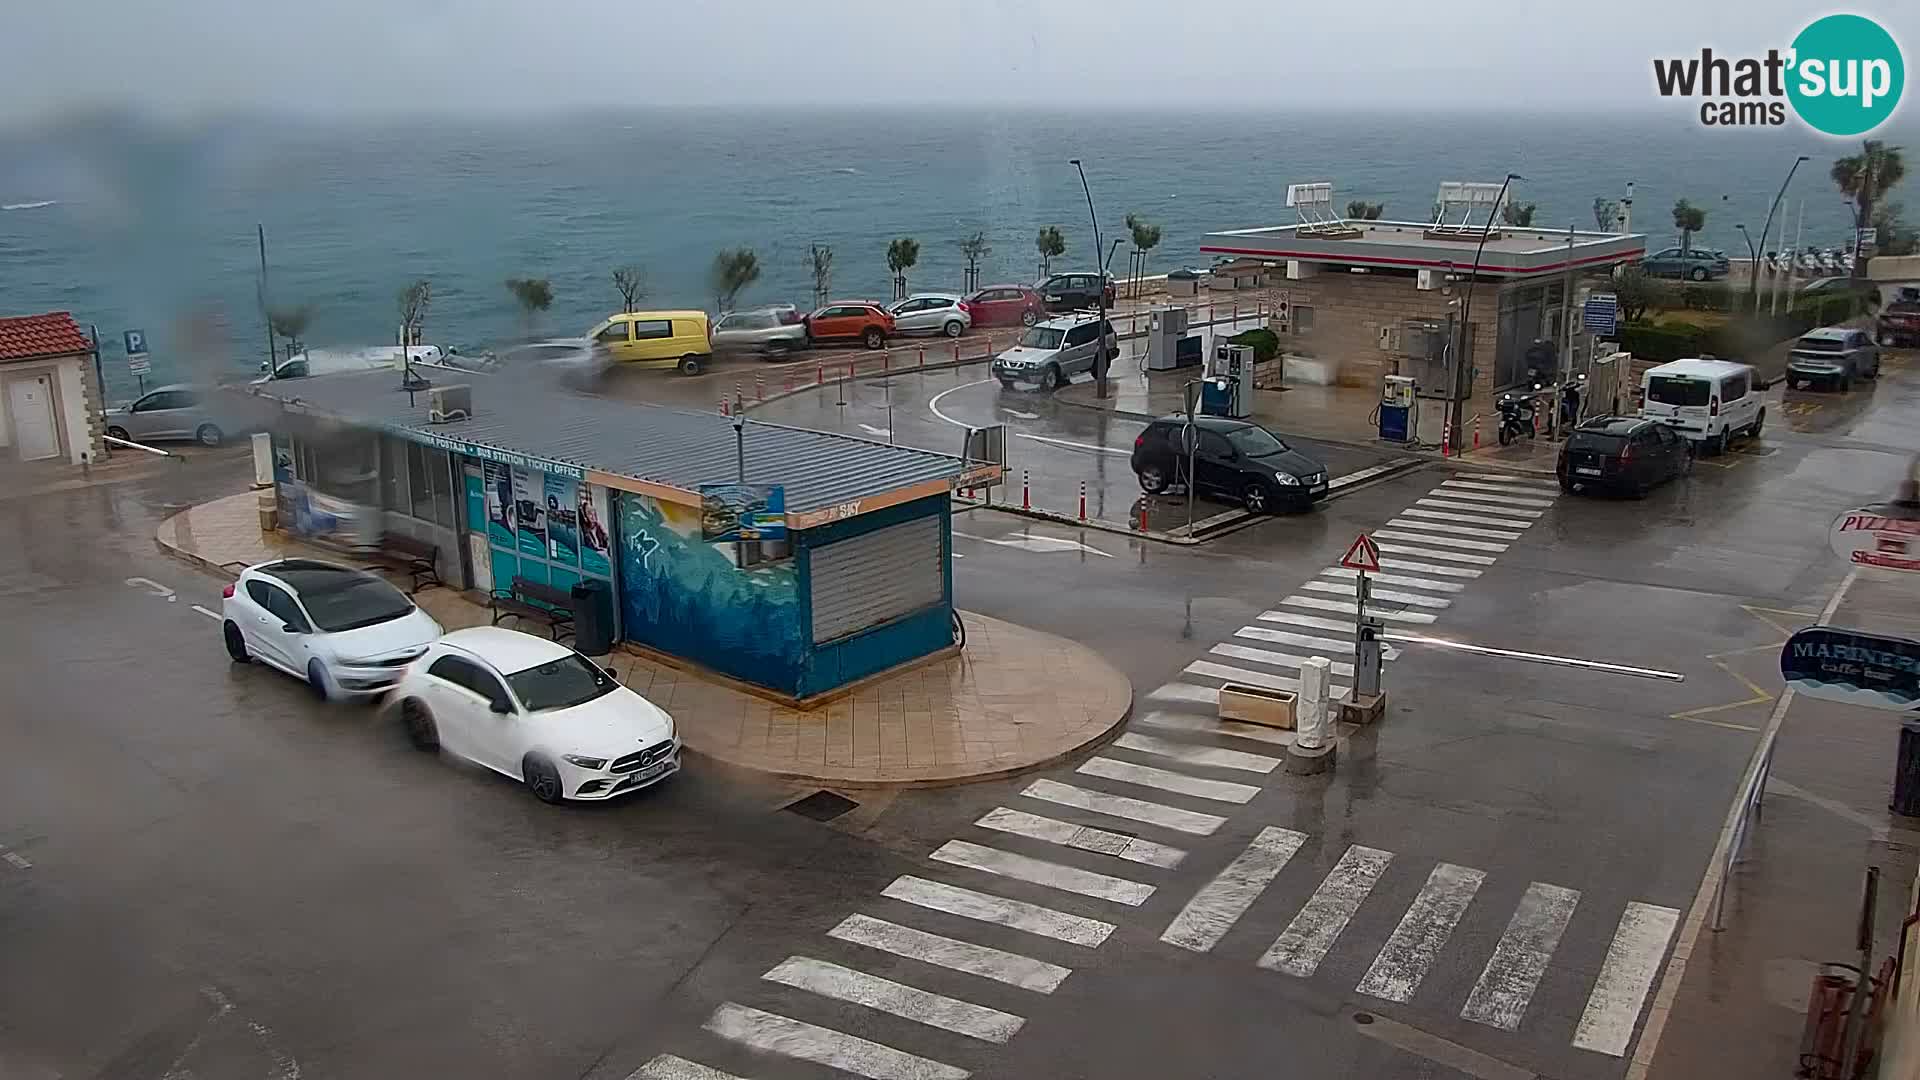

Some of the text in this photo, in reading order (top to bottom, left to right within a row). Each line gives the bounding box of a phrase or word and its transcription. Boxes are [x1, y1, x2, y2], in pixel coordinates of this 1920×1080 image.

[129, 333, 141, 350] P
[477, 447, 581, 478] BUS STATION TICKET OFFICE
